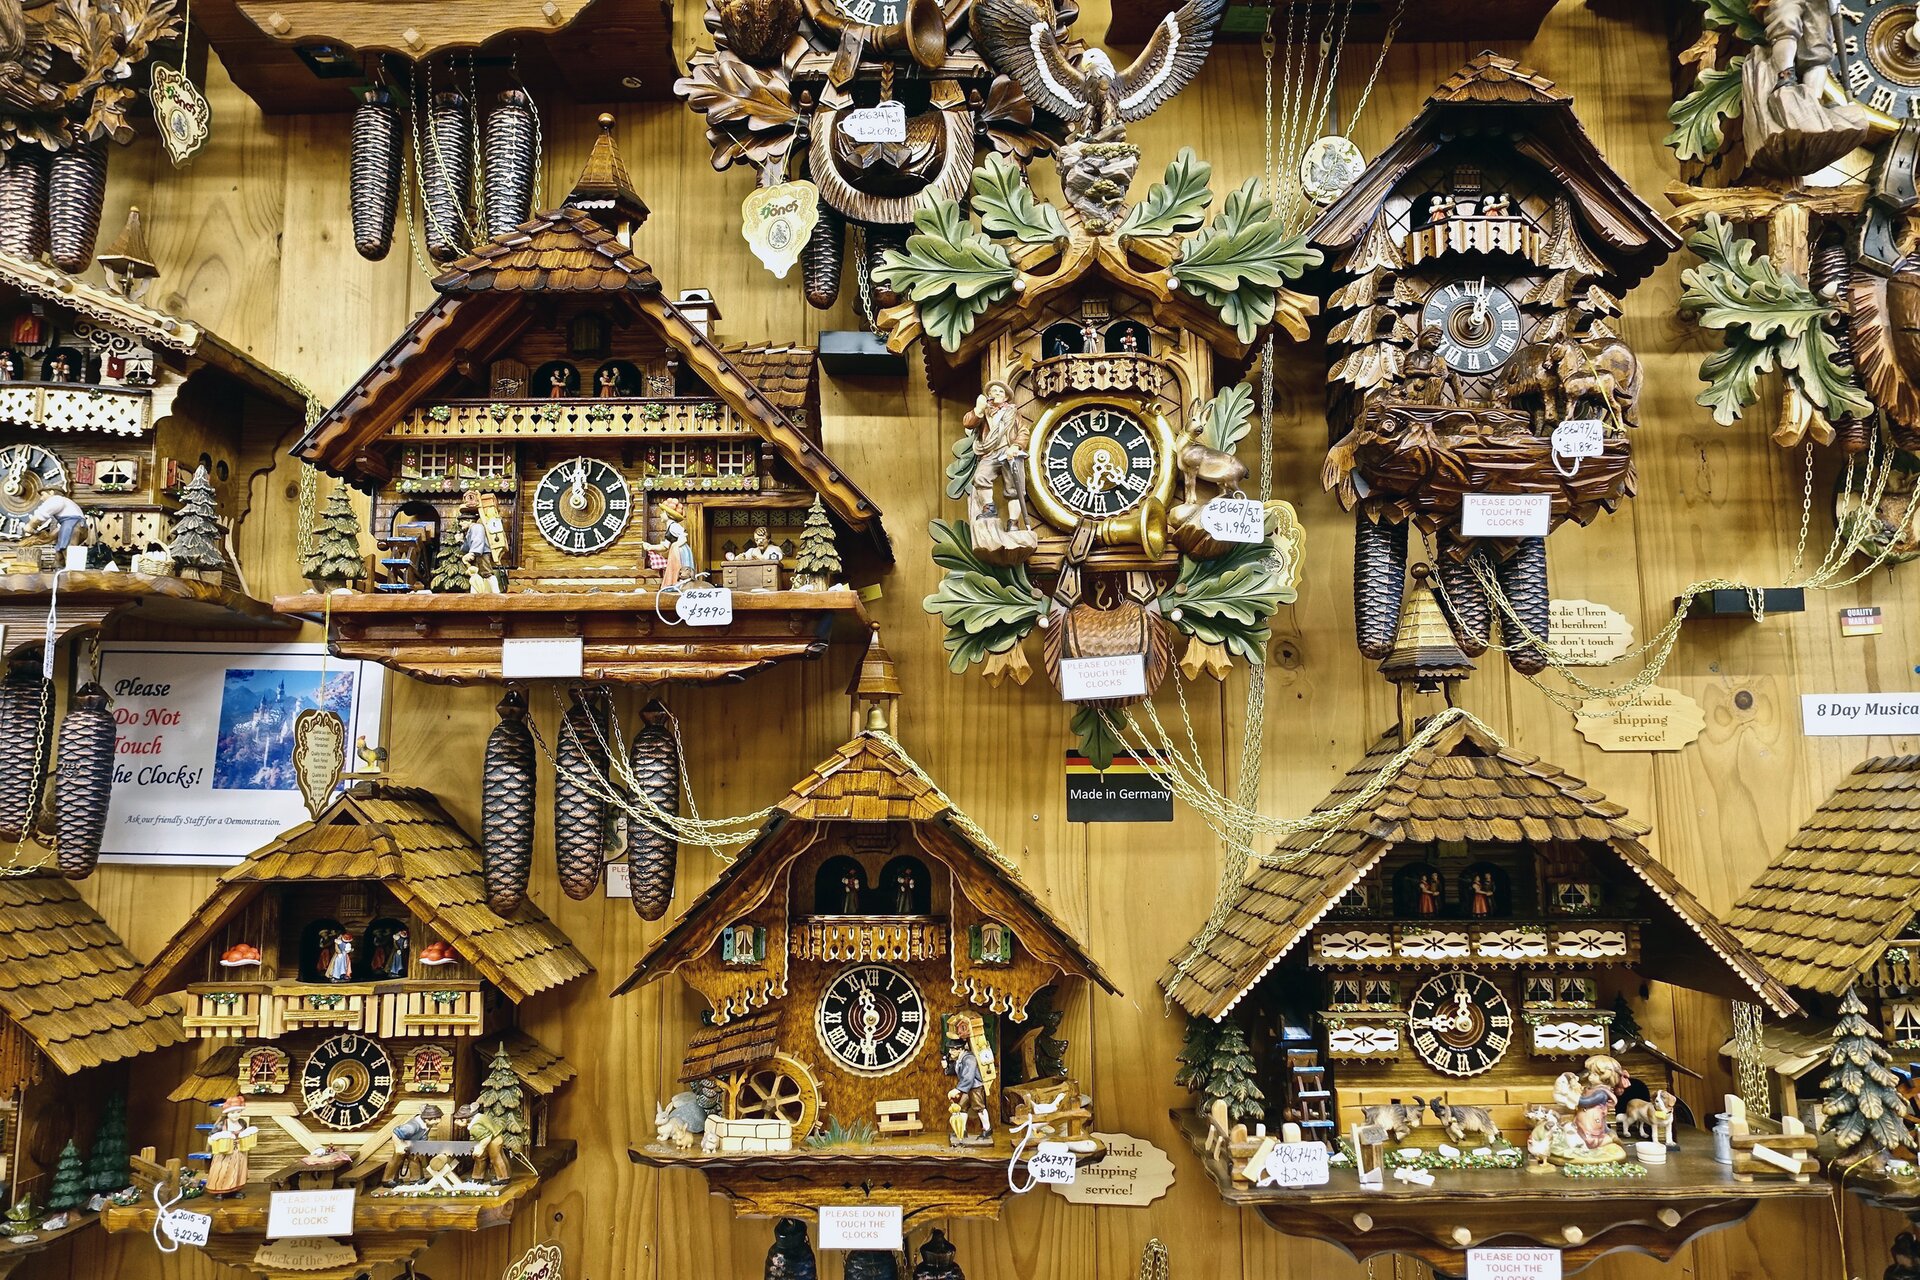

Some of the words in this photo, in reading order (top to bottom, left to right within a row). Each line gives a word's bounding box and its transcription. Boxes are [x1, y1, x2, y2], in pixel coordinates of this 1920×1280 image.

[1560, 607, 1574, 616] die
[1577, 607, 1606, 616] Uhren
[1847, 608, 1873, 617] QUALITY
[1562, 619, 1606, 628] berühren!
[1588, 636, 1614, 646] touch
[1067, 661, 1100, 670] PLEASE
[1104, 660, 1116, 668] DO
[1078, 670, 1108, 678] TOUCH
[1112, 668, 1128, 676] THE
[114, 677, 171, 697] Please
[1086, 679, 1122, 688] CLOCKS
[1817, 704, 1826, 716] 8
[1831, 703, 1860, 719] Day
[1865, 702, 1920, 716] Musica
[112, 708, 139, 725] Do
[143, 708, 180, 726] Not
[1613, 712, 1668, 727] shipping
[1618, 731, 1665, 742] service!
[113, 764, 132, 783] he
[138, 765, 204, 789] Clocks!
[1070, 789, 1103, 800] Made
[1106, 789, 1116, 800] in
[1120, 789, 1171, 801] Germany
[125, 815, 140, 824] Ask
[153, 815, 182, 826] friendly
[184, 816, 204, 826] Staff
[204, 816, 216, 826] for
[224, 817, 280, 826] Demonstration.
[1106, 1143, 1142, 1158] dwide
[1081, 1162, 1138, 1179] shipping
[1086, 1184, 1133, 1196] service!
[320, 1205, 336, 1213] THE
[292, 1216, 328, 1225] CLOCKS
[290, 1238, 322, 1250] 2015
[261, 1251, 290, 1264] Clock
[292, 1254, 303, 1265] of
[304, 1254, 323, 1266] the
[325, 1252, 352, 1264] Year
[1486, 1264, 1520, 1272] TOUCH
[1524, 1264, 1543, 1272] THE
